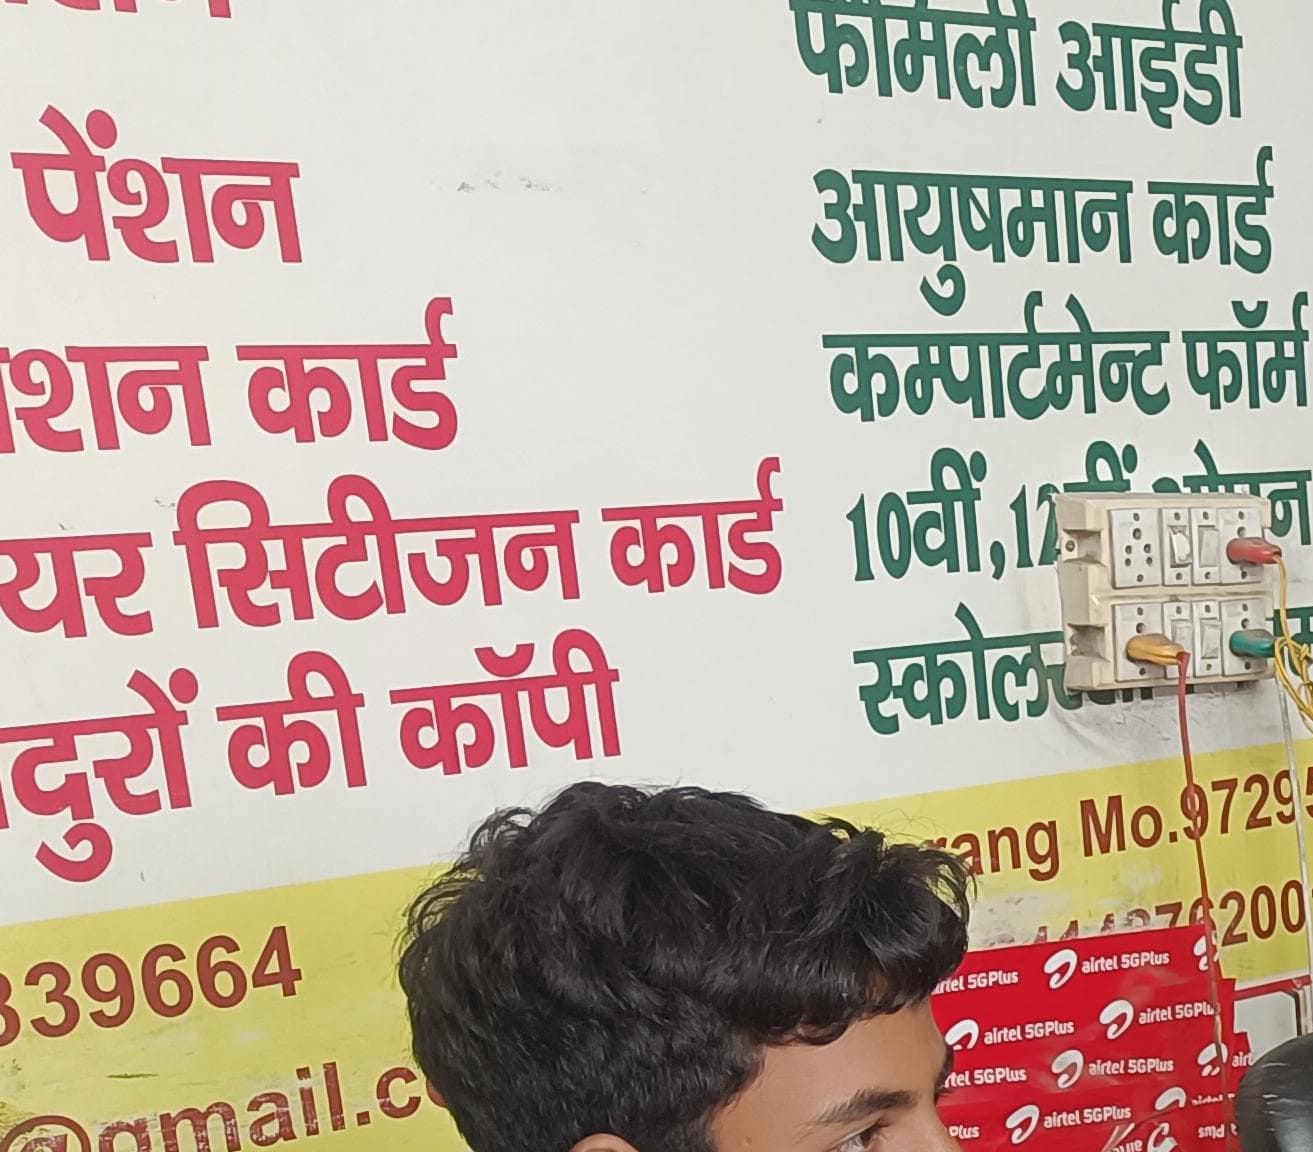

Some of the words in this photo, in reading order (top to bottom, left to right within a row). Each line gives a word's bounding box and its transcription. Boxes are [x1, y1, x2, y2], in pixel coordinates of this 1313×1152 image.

[11, 105, 302, 263] पेंशन
[811, 167, 1134, 316] आयुषमान
[1147, 146, 1275, 275] कार्ड
[236, 297, 458, 450] कार्ड
[821, 290, 1170, 423] कम्पार्टमेन्ट
[1183, 290, 1310, 411] फॉर्म
[173, 473, 579, 629] सिटीजन
[601, 457, 782, 595] कार्ड
[216, 650, 367, 797] की
[390, 628, 621, 776] कॉपी
[1081, 955, 1119, 974] airtel
[1138, 1004, 1173, 1024] airtel
[983, 1025, 1022, 1044] airtel
[1088, 1059, 1125, 1076] airtel
[1043, 1110, 1081, 1129] airtel
